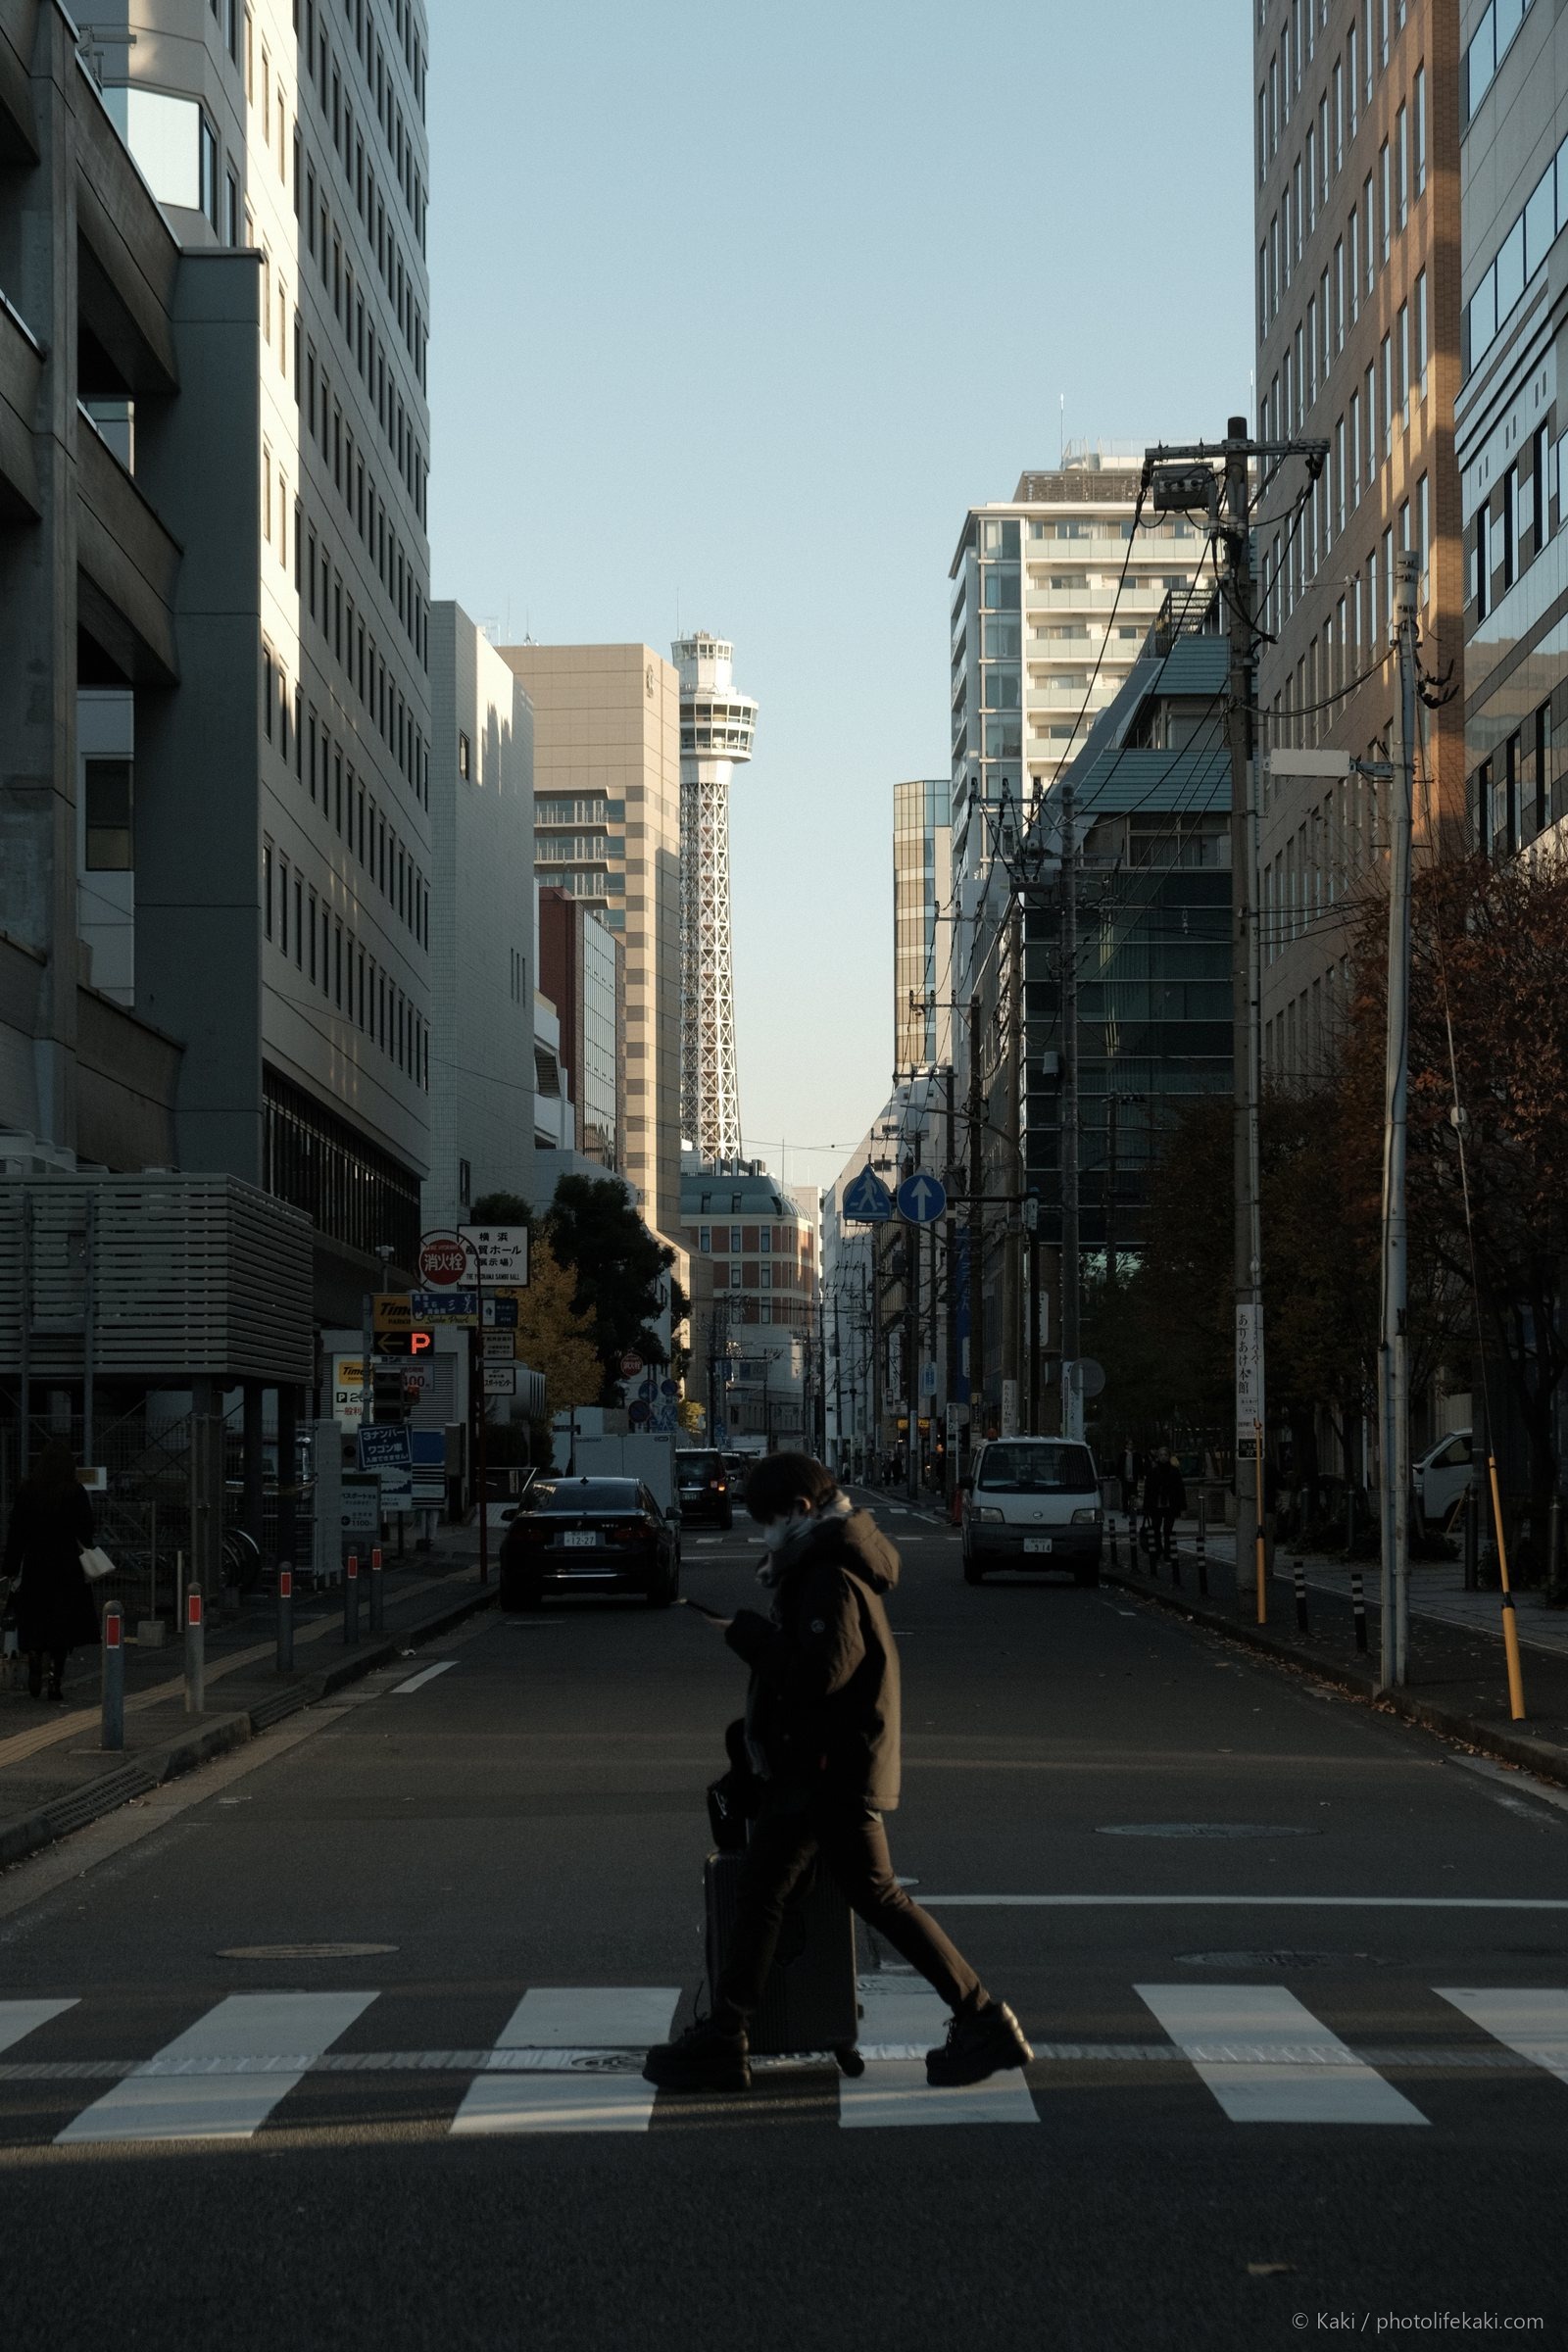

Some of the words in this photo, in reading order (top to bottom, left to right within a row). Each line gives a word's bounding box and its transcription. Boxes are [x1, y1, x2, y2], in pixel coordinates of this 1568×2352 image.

[479, 1233, 508, 1242] 横浜
[424, 1253, 463, 1271] 消火栓
[380, 1302, 411, 1315] Tim
[412, 1333, 431, 1354] P
[1239, 1313, 1249, 1395] ありあけ本館
[364, 1429, 405, 1441] 3ナンバー
[368, 1443, 403, 1454] ワゴン車
